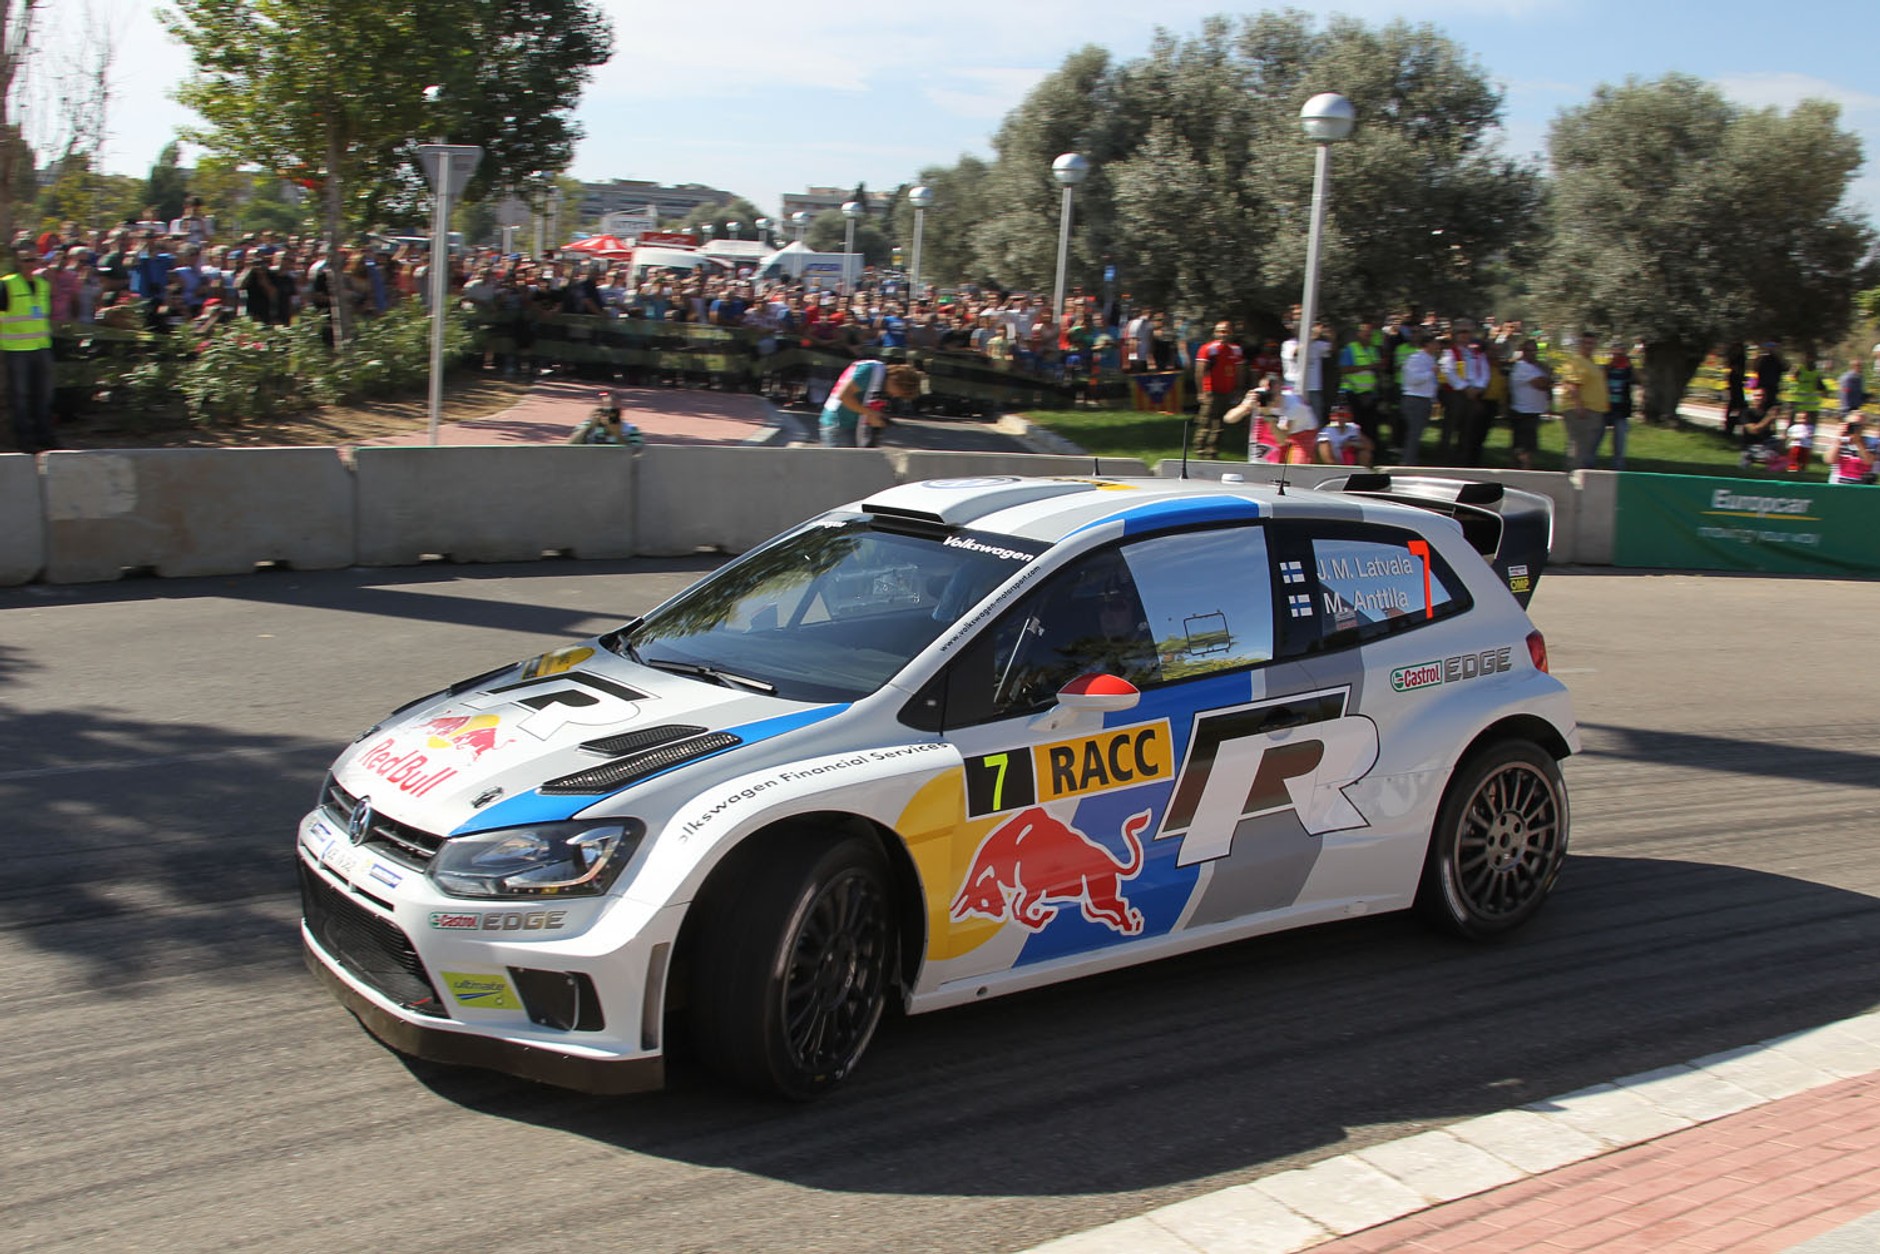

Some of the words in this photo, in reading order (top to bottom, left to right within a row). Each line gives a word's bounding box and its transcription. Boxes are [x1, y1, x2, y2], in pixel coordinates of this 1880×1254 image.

[1711, 488, 1813, 518] Europcar
[943, 536, 1035, 562] Volkswagen
[1316, 558, 1330, 581] J.
[1332, 558, 1354, 580] M.
[1355, 554, 1414, 578] Latvala
[1407, 540, 1434, 619] 7
[1510, 579, 1529, 590] OMP
[940, 565, 1041, 652] www.volkswagen-motorsport.com
[1324, 592, 1348, 615] M.
[1354, 588, 1409, 611] Anttila
[1404, 664, 1440, 688] Castrol
[1444, 647, 1512, 683] EDGE
[779, 756, 870, 782] Financial
[870, 742, 949, 761] Services
[1050, 729, 1159, 795] RACC
[1154, 683, 1381, 869] R
[983, 753, 1008, 812] 7
[481, 910, 568, 931] EDGE
